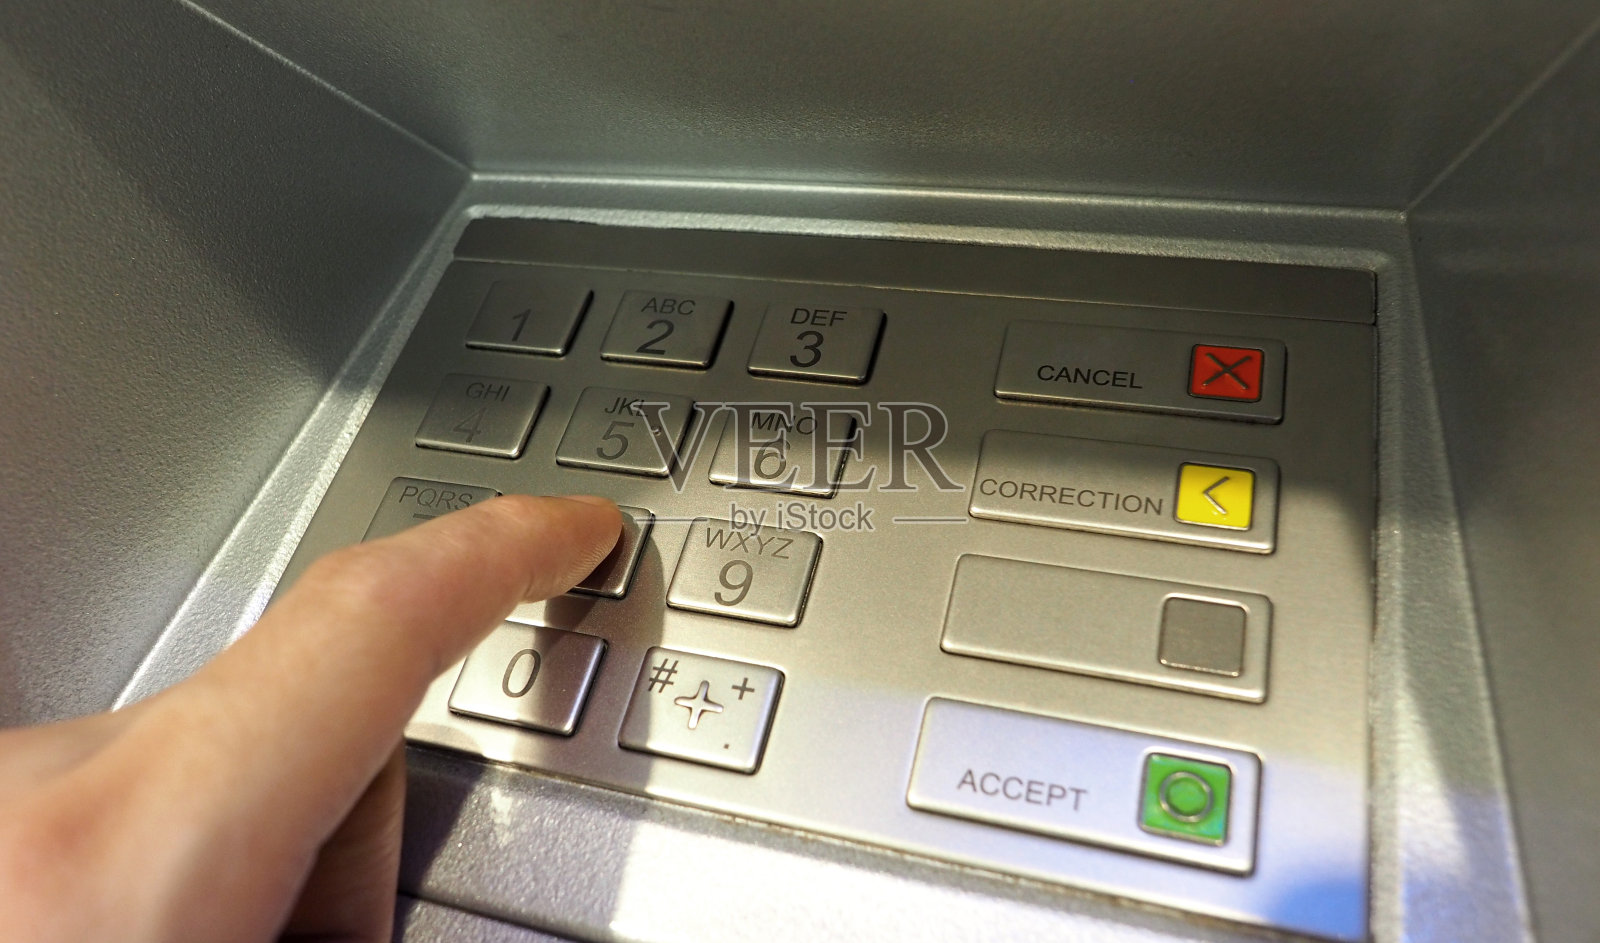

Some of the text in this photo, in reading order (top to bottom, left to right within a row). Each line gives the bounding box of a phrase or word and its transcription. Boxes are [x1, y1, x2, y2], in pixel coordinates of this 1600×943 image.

[641, 296, 695, 316] ABC
[790, 308, 847, 327] DEF
[512, 309, 532, 342] 1
[636, 319, 675, 355] 2
[790, 330, 824, 368] 3
[466, 382, 511, 400] GHI
[1037, 365, 1143, 389] CANCEL
[605, 397, 648, 417] JKL
[751, 411, 818, 435] MNO
[453, 407, 488, 443] 4
[596, 420, 635, 460] 5
[754, 438, 790, 479] 6
[399, 485, 473, 509] PQRS
[979, 478, 1164, 516] CORRECTION
[706, 527, 794, 559] WXYZ
[714, 559, 754, 607] 9
[501, 648, 541, 698] 0
[648, 658, 679, 693] #
[957, 769, 1088, 811] ACCEPT
